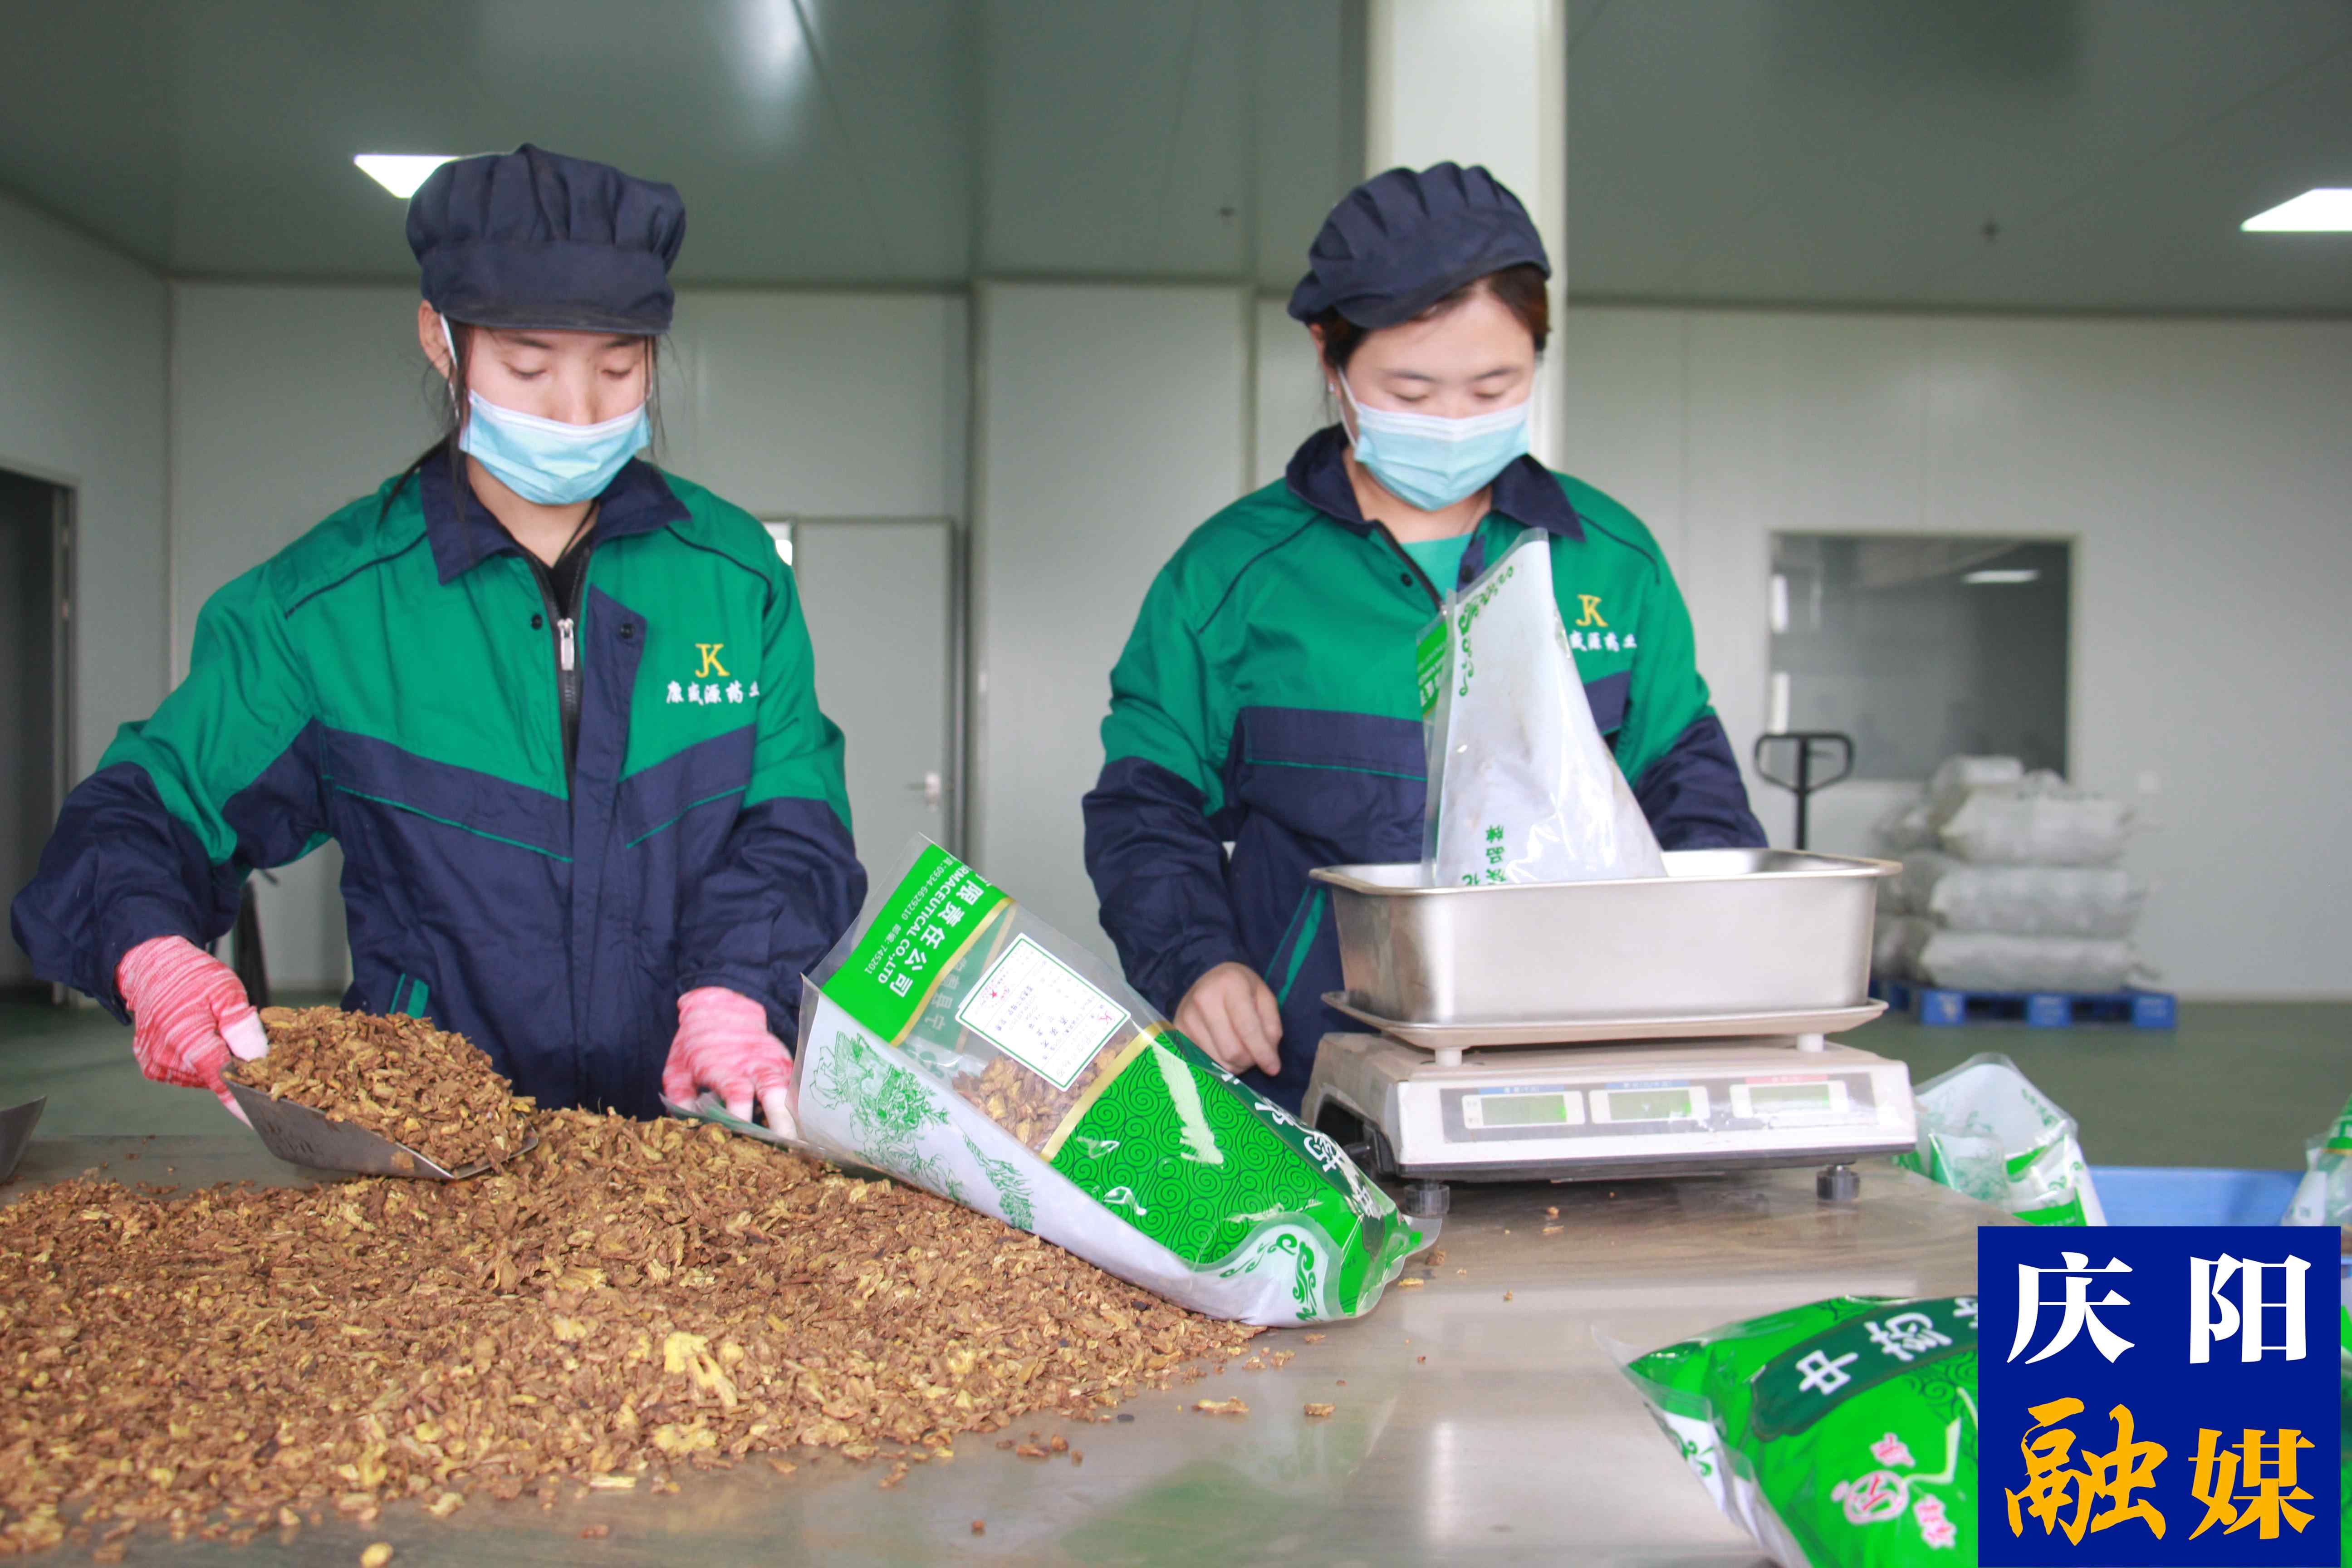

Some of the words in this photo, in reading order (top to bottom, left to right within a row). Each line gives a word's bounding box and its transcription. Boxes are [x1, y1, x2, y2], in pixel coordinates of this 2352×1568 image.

[695, 643, 730, 677] JK
[906, 866, 974, 936] RMACEUTICAL
[864, 945, 887, 974] 745201
[878, 939, 910, 984] CO.,LTD
